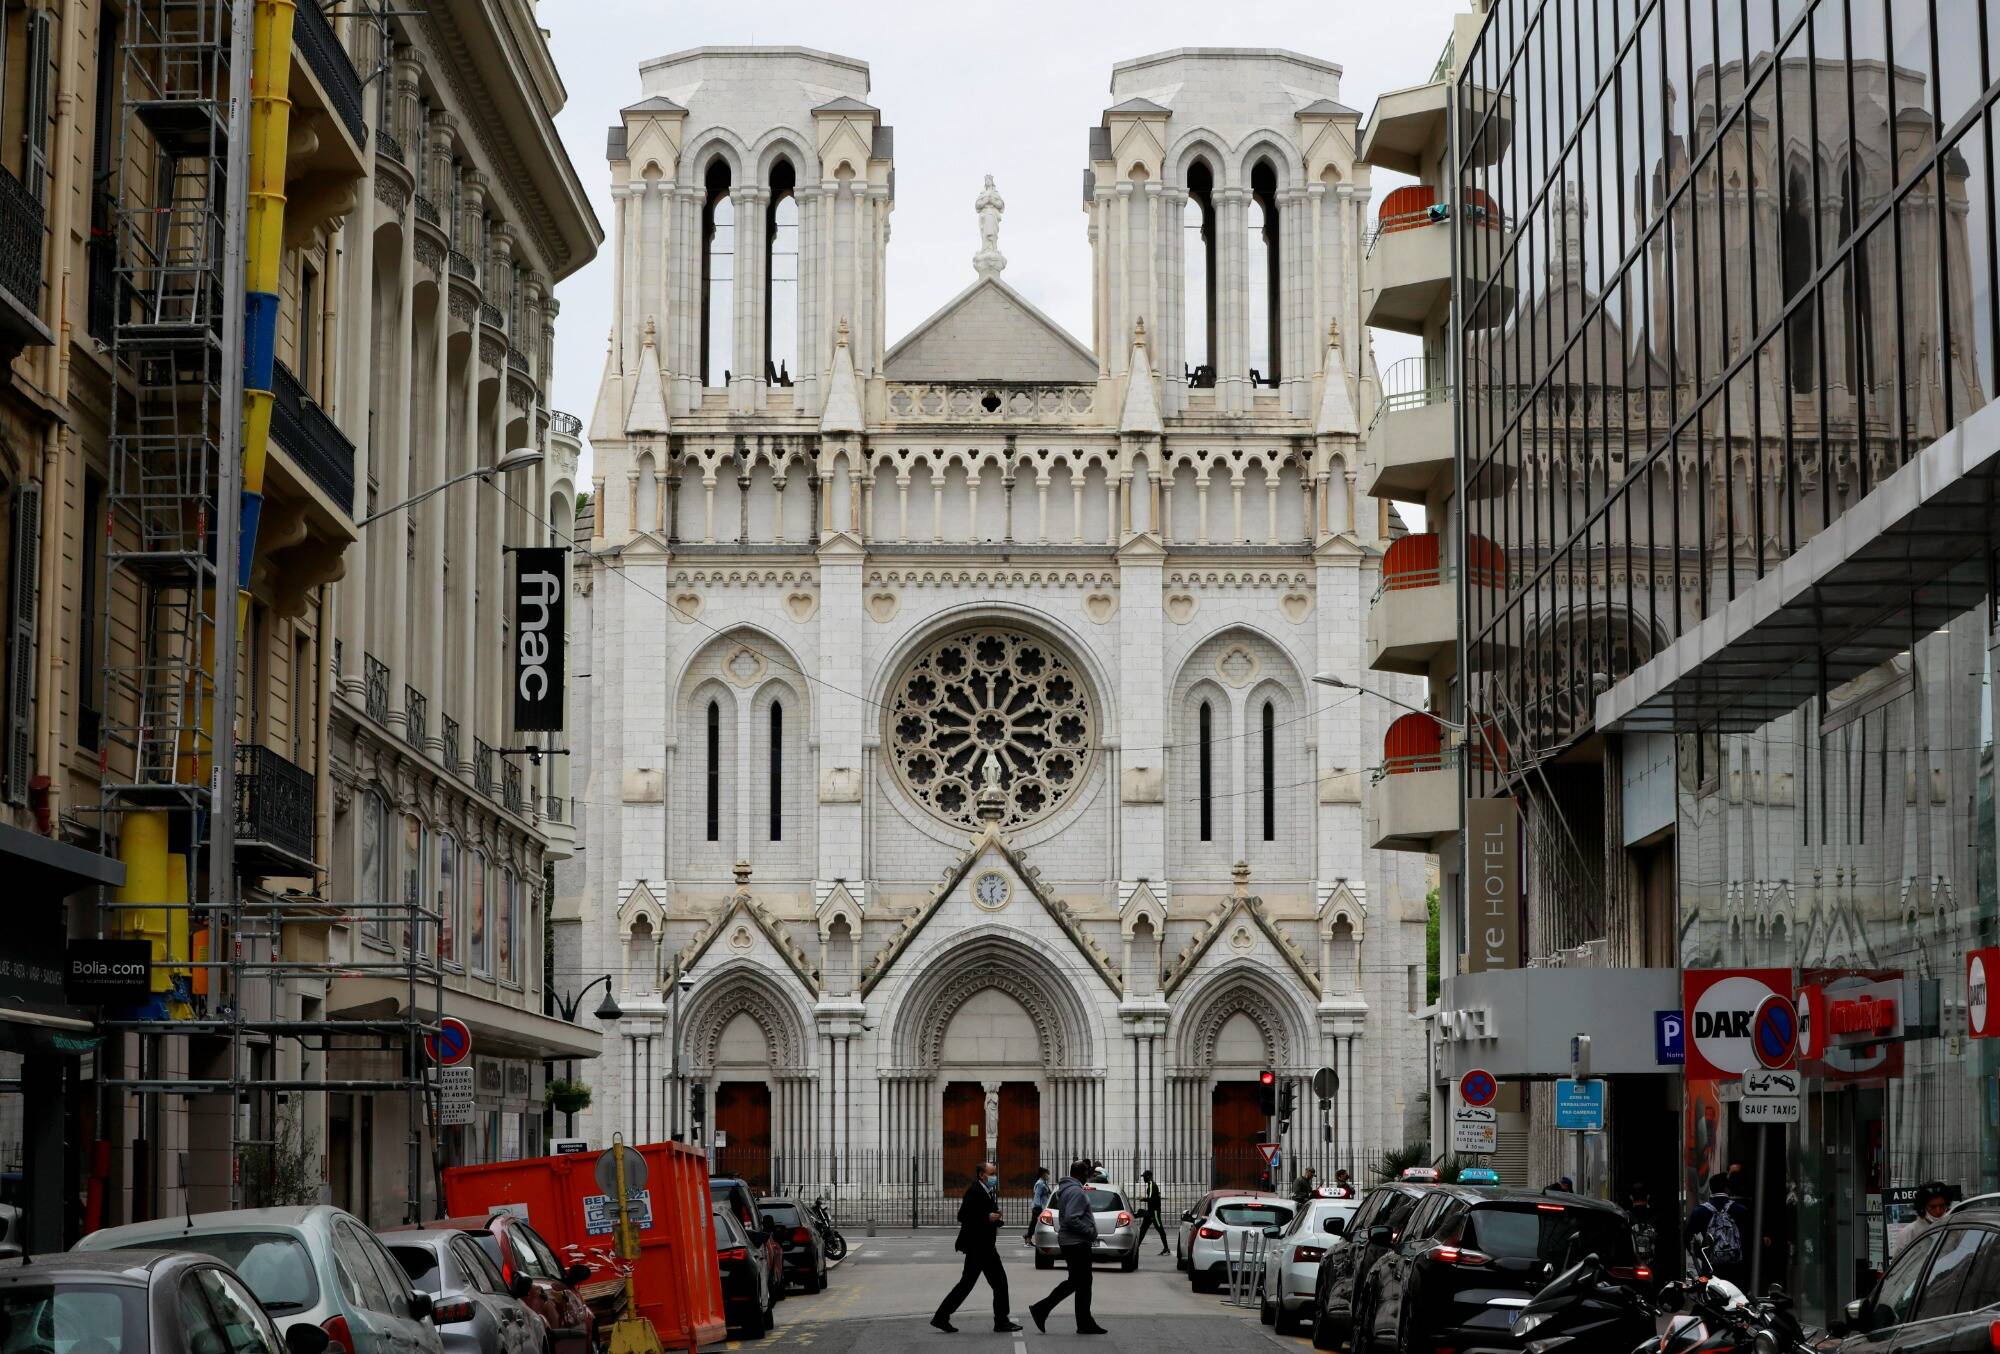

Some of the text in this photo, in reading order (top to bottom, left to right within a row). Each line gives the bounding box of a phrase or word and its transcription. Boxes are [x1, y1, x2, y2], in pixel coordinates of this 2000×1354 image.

[520, 569, 560, 702] fnac
[1484, 823, 1505, 916] HOTEL
[1663, 1020, 1681, 1047] P
[1695, 1010, 1756, 1039] DAR
[1744, 1104, 1797, 1115] SAUF TAXIS
[1893, 1191, 1900, 1200] A
